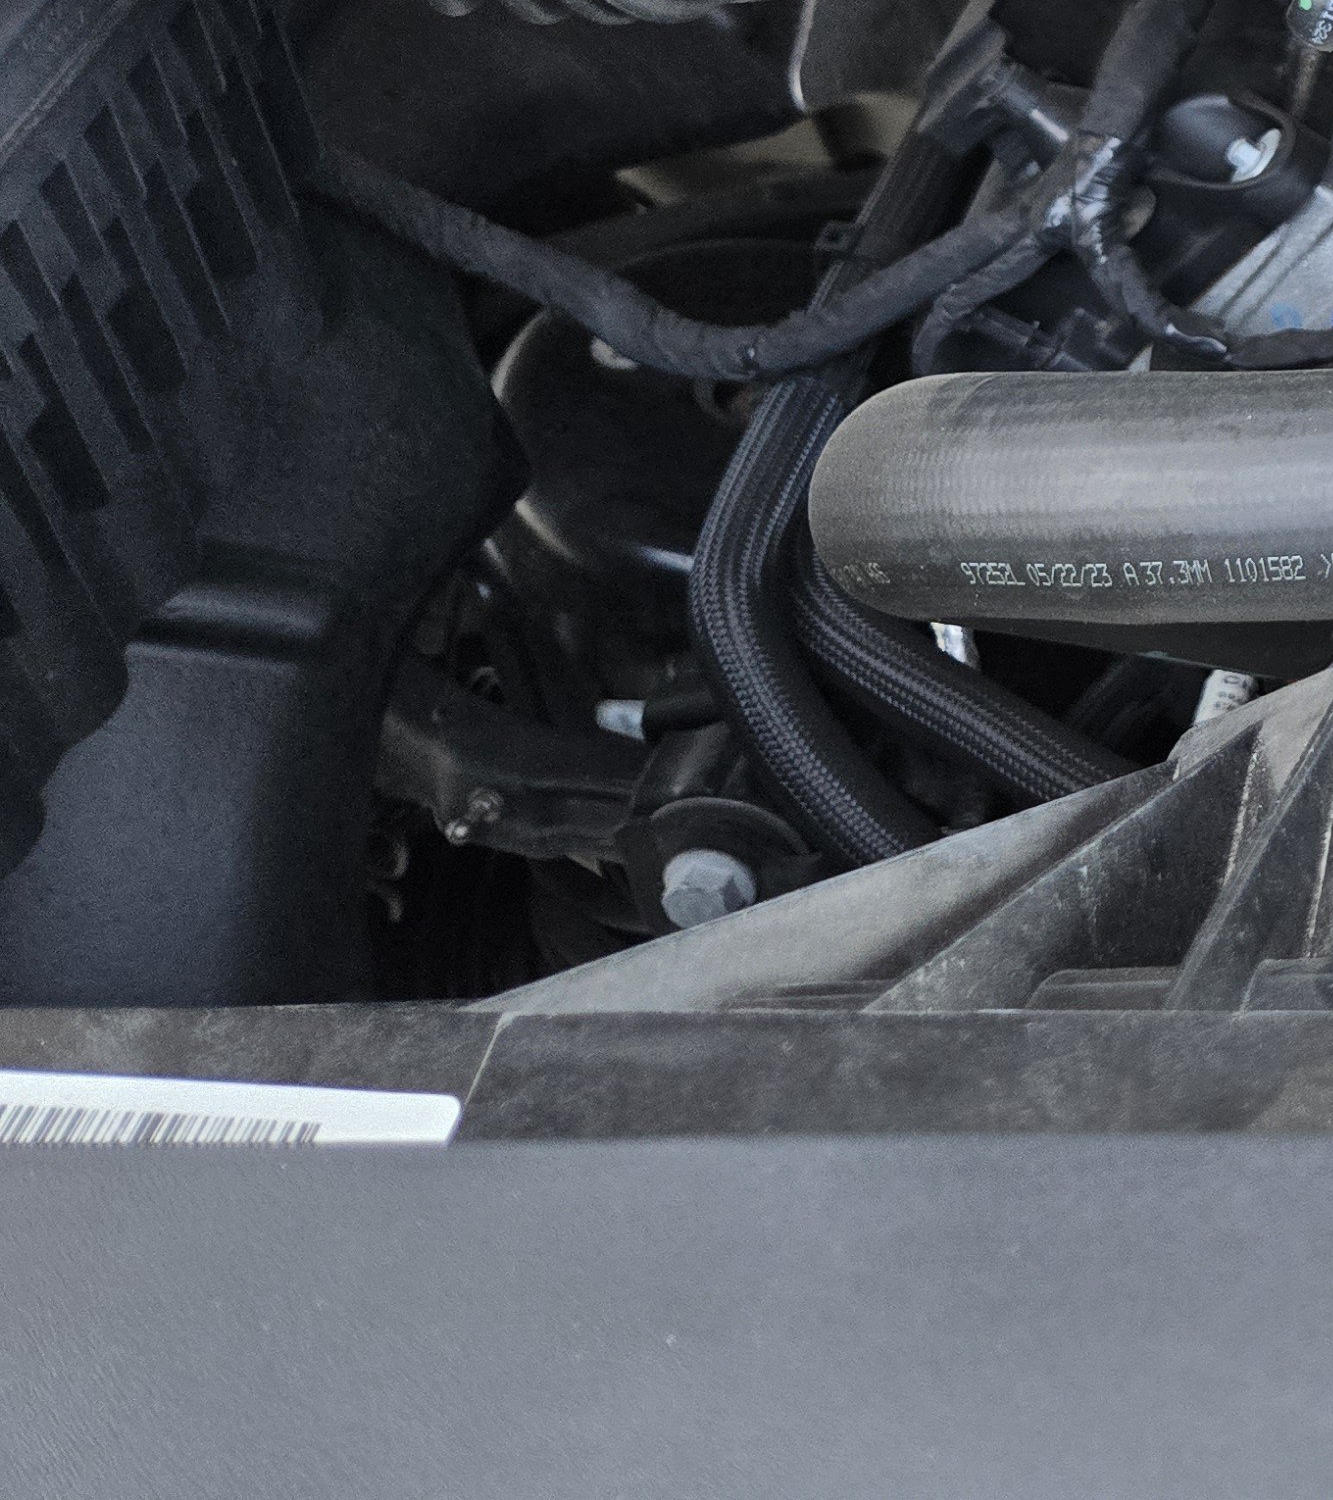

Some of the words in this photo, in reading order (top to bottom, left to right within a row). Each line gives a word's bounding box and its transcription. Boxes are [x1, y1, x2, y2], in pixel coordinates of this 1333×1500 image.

[961, 562, 1026, 588] 97252L
[1027, 562, 1113, 588] 05/22/23
[1224, 555, 1307, 584] 1101582
